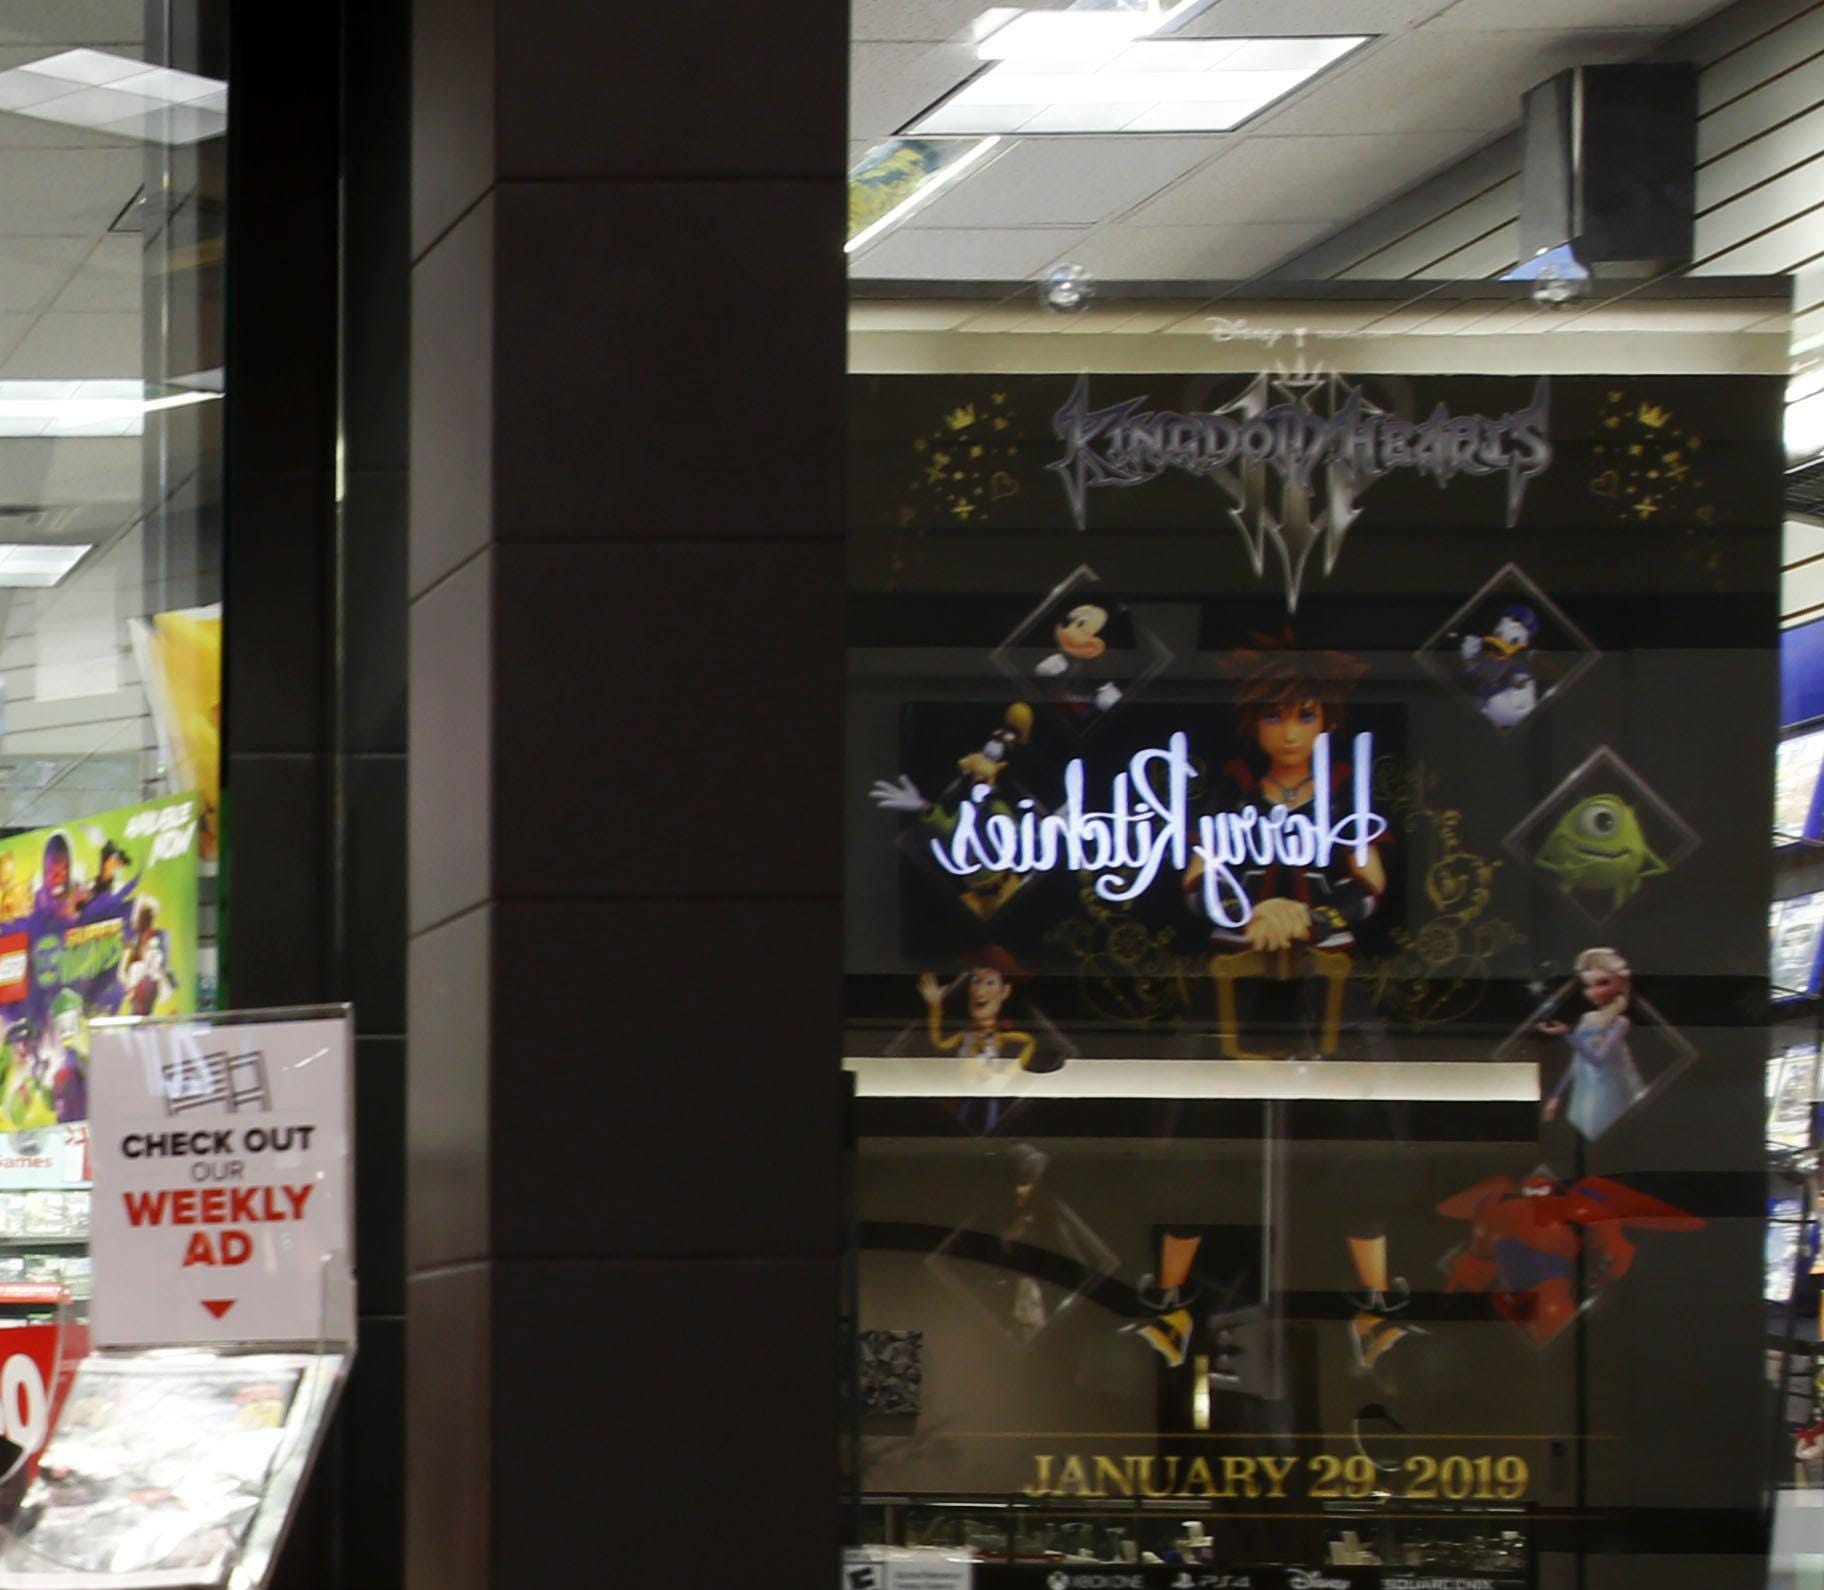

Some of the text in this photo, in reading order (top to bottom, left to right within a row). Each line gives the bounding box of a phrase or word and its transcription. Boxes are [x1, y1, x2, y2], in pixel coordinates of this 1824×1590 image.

[122, 1125, 316, 1160] CHECK OUT
[190, 1159, 246, 1183] OUR
[123, 1184, 314, 1228] WEEKLY
[183, 1229, 254, 1268] AD
[1024, 1455, 1529, 1501] JANUARY 29, 2019
